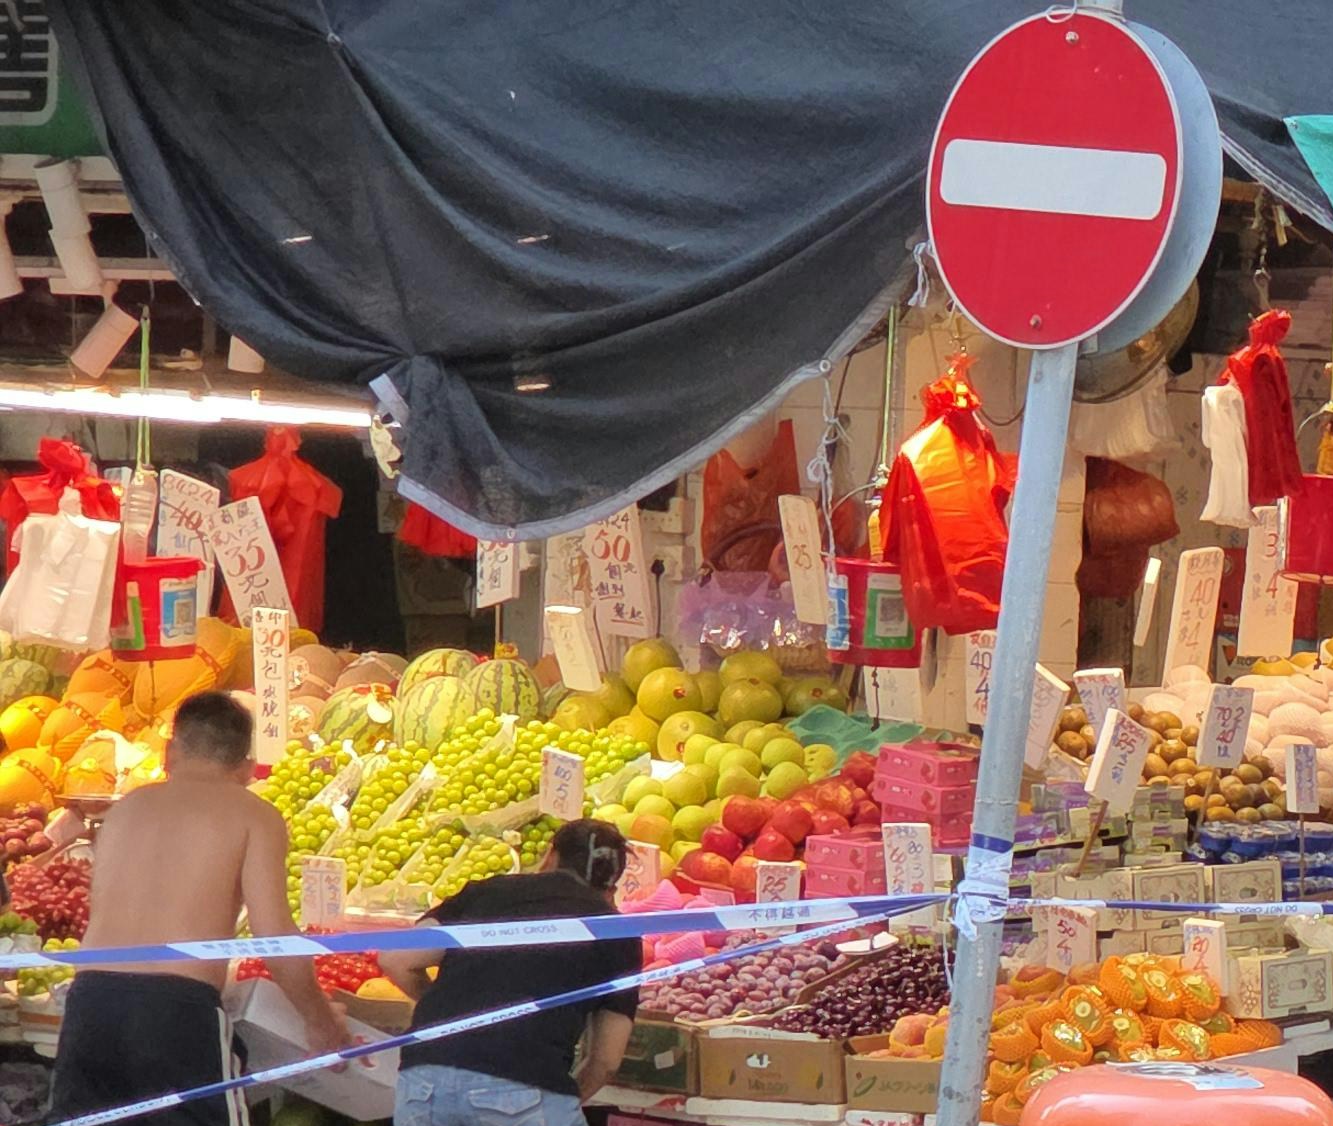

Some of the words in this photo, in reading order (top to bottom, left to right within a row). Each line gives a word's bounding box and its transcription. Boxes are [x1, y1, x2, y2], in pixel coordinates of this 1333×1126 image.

[224, 537, 266, 578] 35
[592, 530, 632, 562] 50
[970, 650, 993, 671] 40
[481, 928, 497, 938] DO
[499, 927, 520, 937] NOT
[523, 924, 558, 936] CROSS
